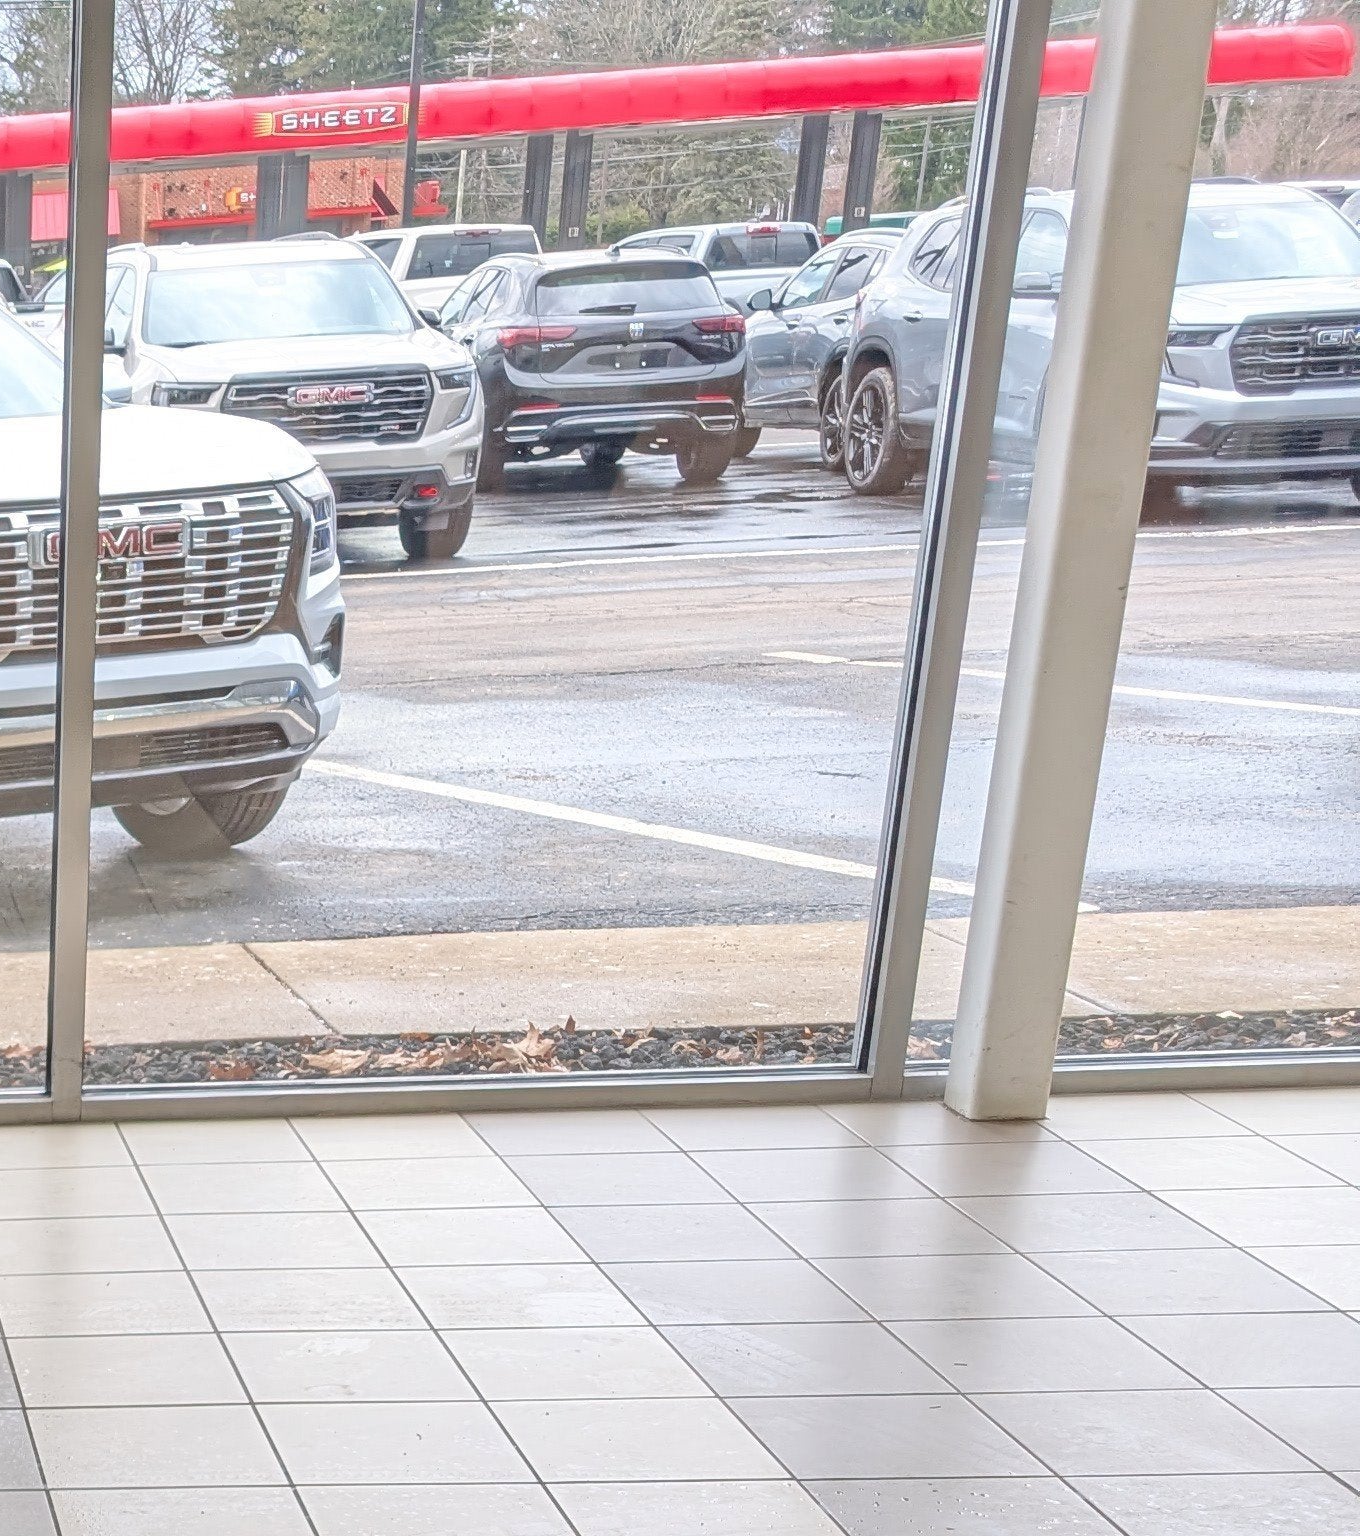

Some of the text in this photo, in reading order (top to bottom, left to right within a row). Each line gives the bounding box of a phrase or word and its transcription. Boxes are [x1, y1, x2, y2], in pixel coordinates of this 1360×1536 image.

[281, 106, 397, 132] SHEETZ
[296, 385, 369, 405] GMC
[45, 521, 185, 564] MC
